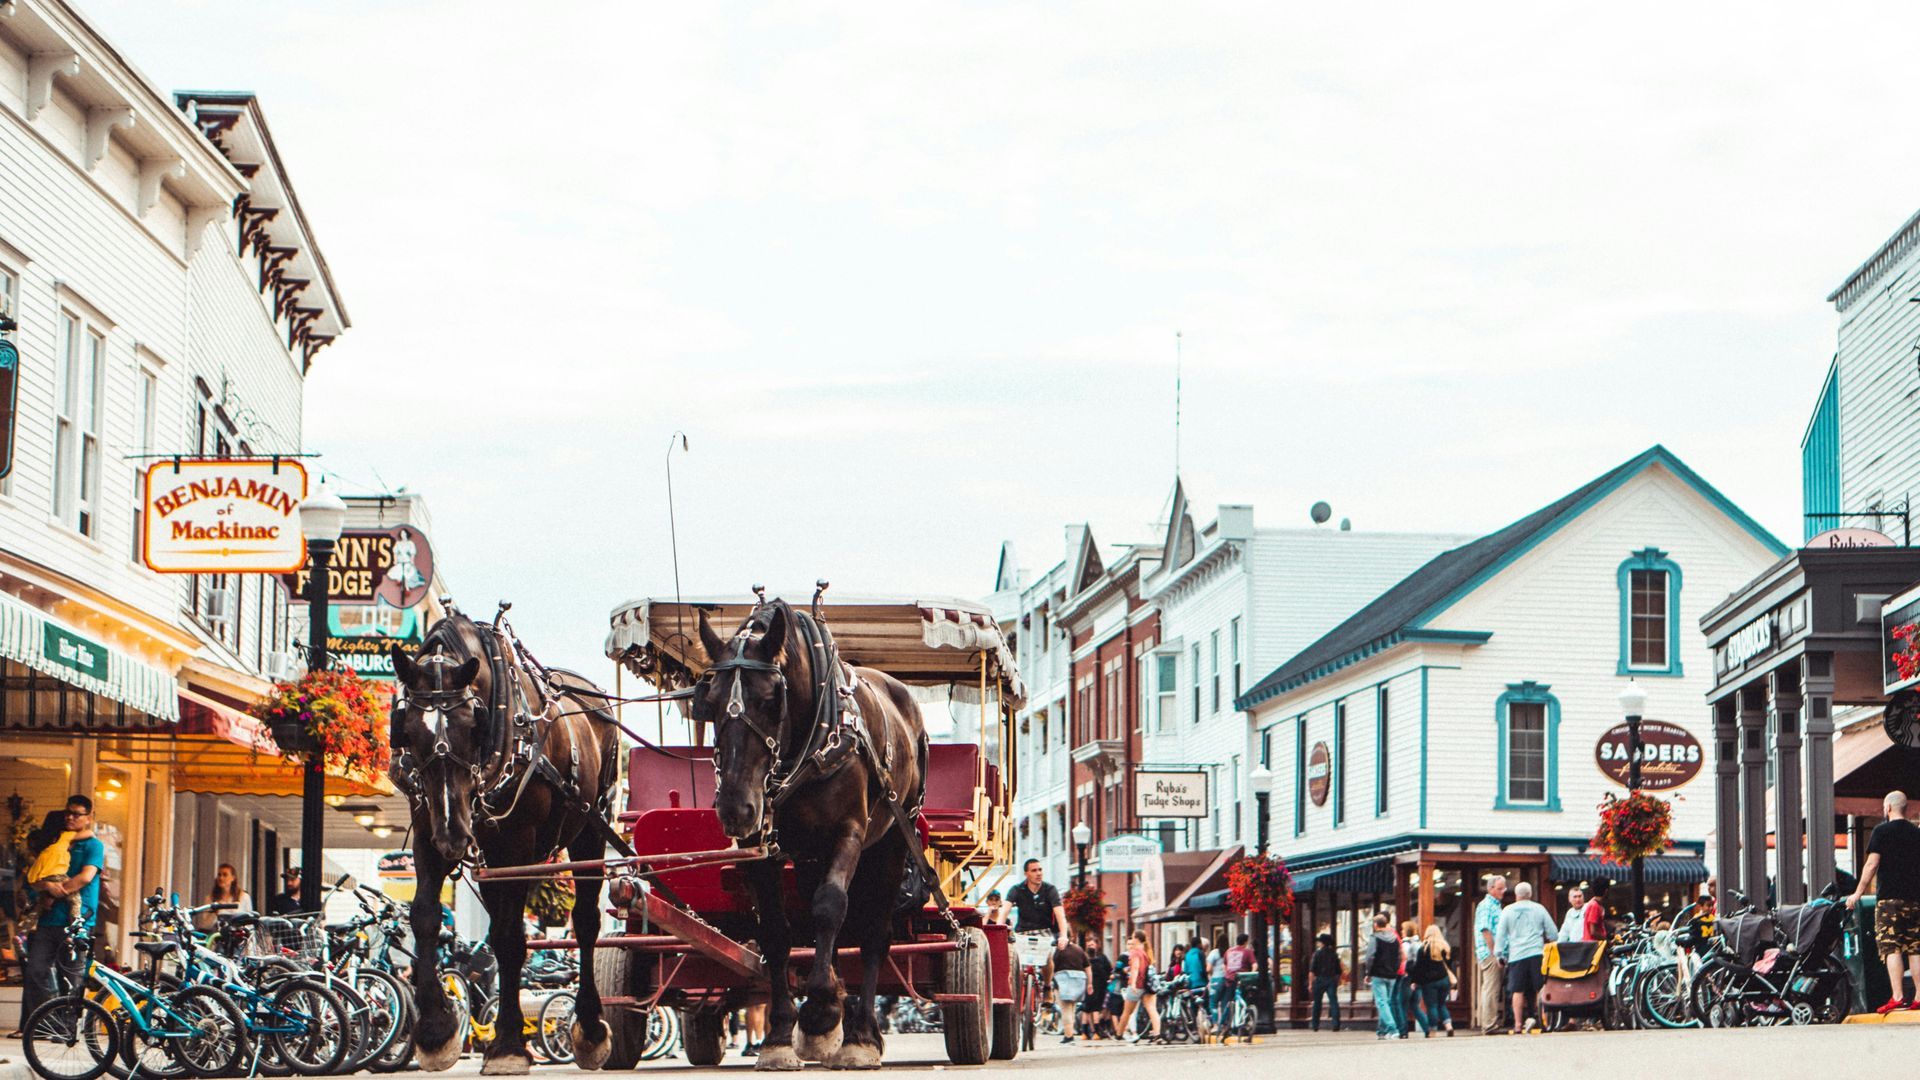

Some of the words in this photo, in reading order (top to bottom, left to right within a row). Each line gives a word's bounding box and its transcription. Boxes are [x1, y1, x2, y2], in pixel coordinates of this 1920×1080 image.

[153, 477, 299, 518] BENJAMIN
[217, 503, 234, 516] of
[171, 519, 280, 541] Mackinac
[307, 537, 392, 568] NN'S
[295, 569, 373, 596] FDGE
[327, 637, 379, 654] Mighty
[1728, 612, 1771, 670] STARBUCKS
[1600, 742, 1699, 763] SADERS
[1156, 779, 1188, 796] Ryba's
[1143, 793, 1169, 809] Fudge
[1171, 795, 1201, 809] Shops
